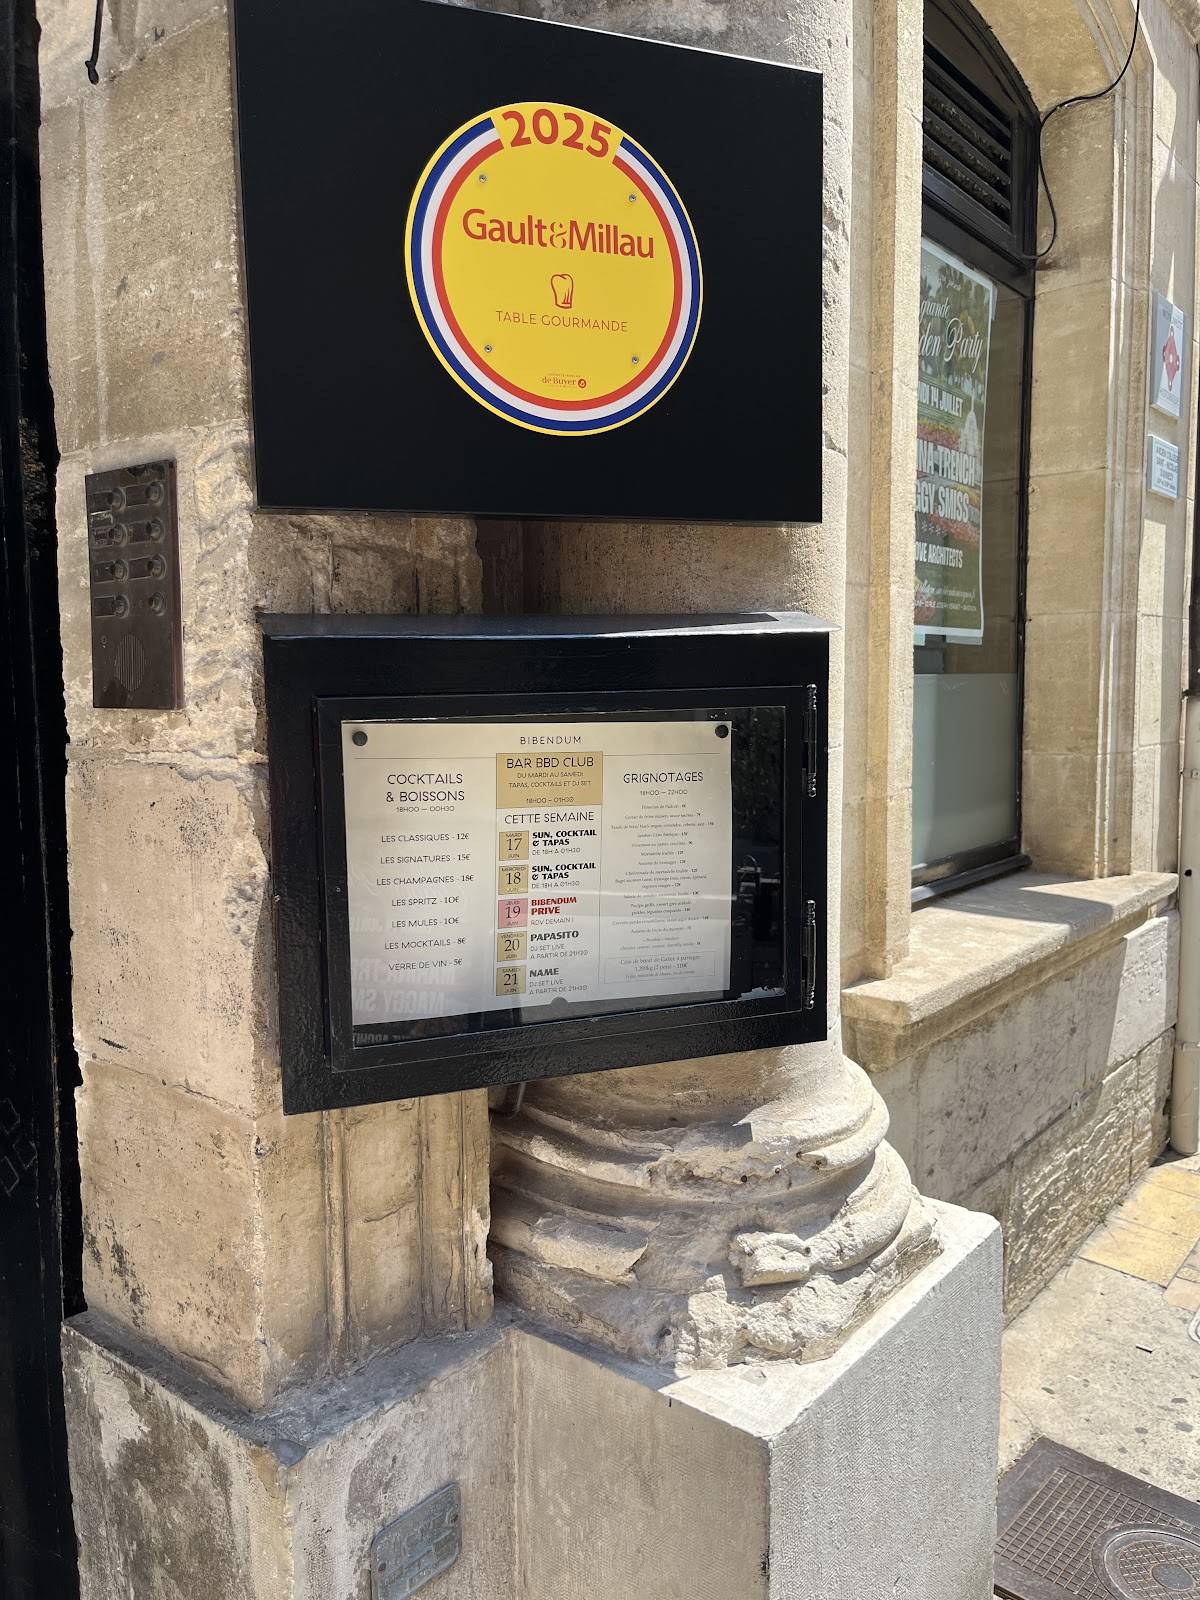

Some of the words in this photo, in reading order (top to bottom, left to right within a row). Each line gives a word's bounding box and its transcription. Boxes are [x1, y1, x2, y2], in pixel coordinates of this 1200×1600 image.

[501, 107, 612, 158] 2025
[495, 310, 537, 325] TABLE
[541, 313, 628, 333] GOURMANDE
[944, 317, 984, 373] Party
[931, 386, 939, 409] 14
[940, 390, 964, 418] JUILLET
[937, 445, 976, 487] TRENCH
[938, 486, 969, 523] SMISS
[928, 543, 963, 568] ARCHITECTS
[520, 736, 582, 745] BIBENDUM
[506, 758, 532, 768] BAR
[536, 757, 559, 768] BBD
[563, 757, 594, 767] CLUB
[387, 773, 463, 785] COCKTAILS
[623, 771, 704, 784] GRIGNOTAGES
[386, 792, 395, 802] &
[399, 791, 465, 802] BOISSONS
[504, 814, 540, 824] CETTE
[543, 811, 594, 822] SEMAINE
[381, 834, 396, 843] LES
[397, 833, 450, 843] CLASSIQUES
[456, 832, 469, 840] 12€
[532, 831, 553, 839] SUN,
[555, 829, 597, 838] COCKTAIL
[506, 838, 523, 851] 17
[543, 839, 570, 847] TAPAS
[380, 856, 395, 864] LES
[396, 854, 451, 864] SIGNATURES
[457, 854, 471, 862] 15€
[555, 862, 597, 871] COCKTAIL
[376, 878, 391, 886] LES
[393, 875, 455, 886] CHAMPAGNES
[461, 874, 475, 882] 18€
[505, 871, 522, 885] 18
[542, 872, 569, 880] TAPAS
[391, 899, 406, 907] LES
[408, 898, 437, 906] SPRITZ
[443, 896, 460, 904] 10€
[531, 896, 577, 907] BIBENDUM
[505, 905, 521, 919] 19
[391, 920, 406, 928] LES
[407, 919, 438, 928] MULES
[443, 917, 460, 925] 10€
[530, 930, 579, 941] PAPASITO
[384, 941, 399, 950] LES
[400, 938, 451, 949] MOCKTAILS
[457, 937, 466, 945] 8€
[504, 939, 520, 952] 20
[388, 962, 417, 971] VERRE
[418, 960, 430, 969] DE
[431, 959, 448, 968] VIN
[529, 967, 560, 978] NAME
[503, 973, 518, 986] 21
